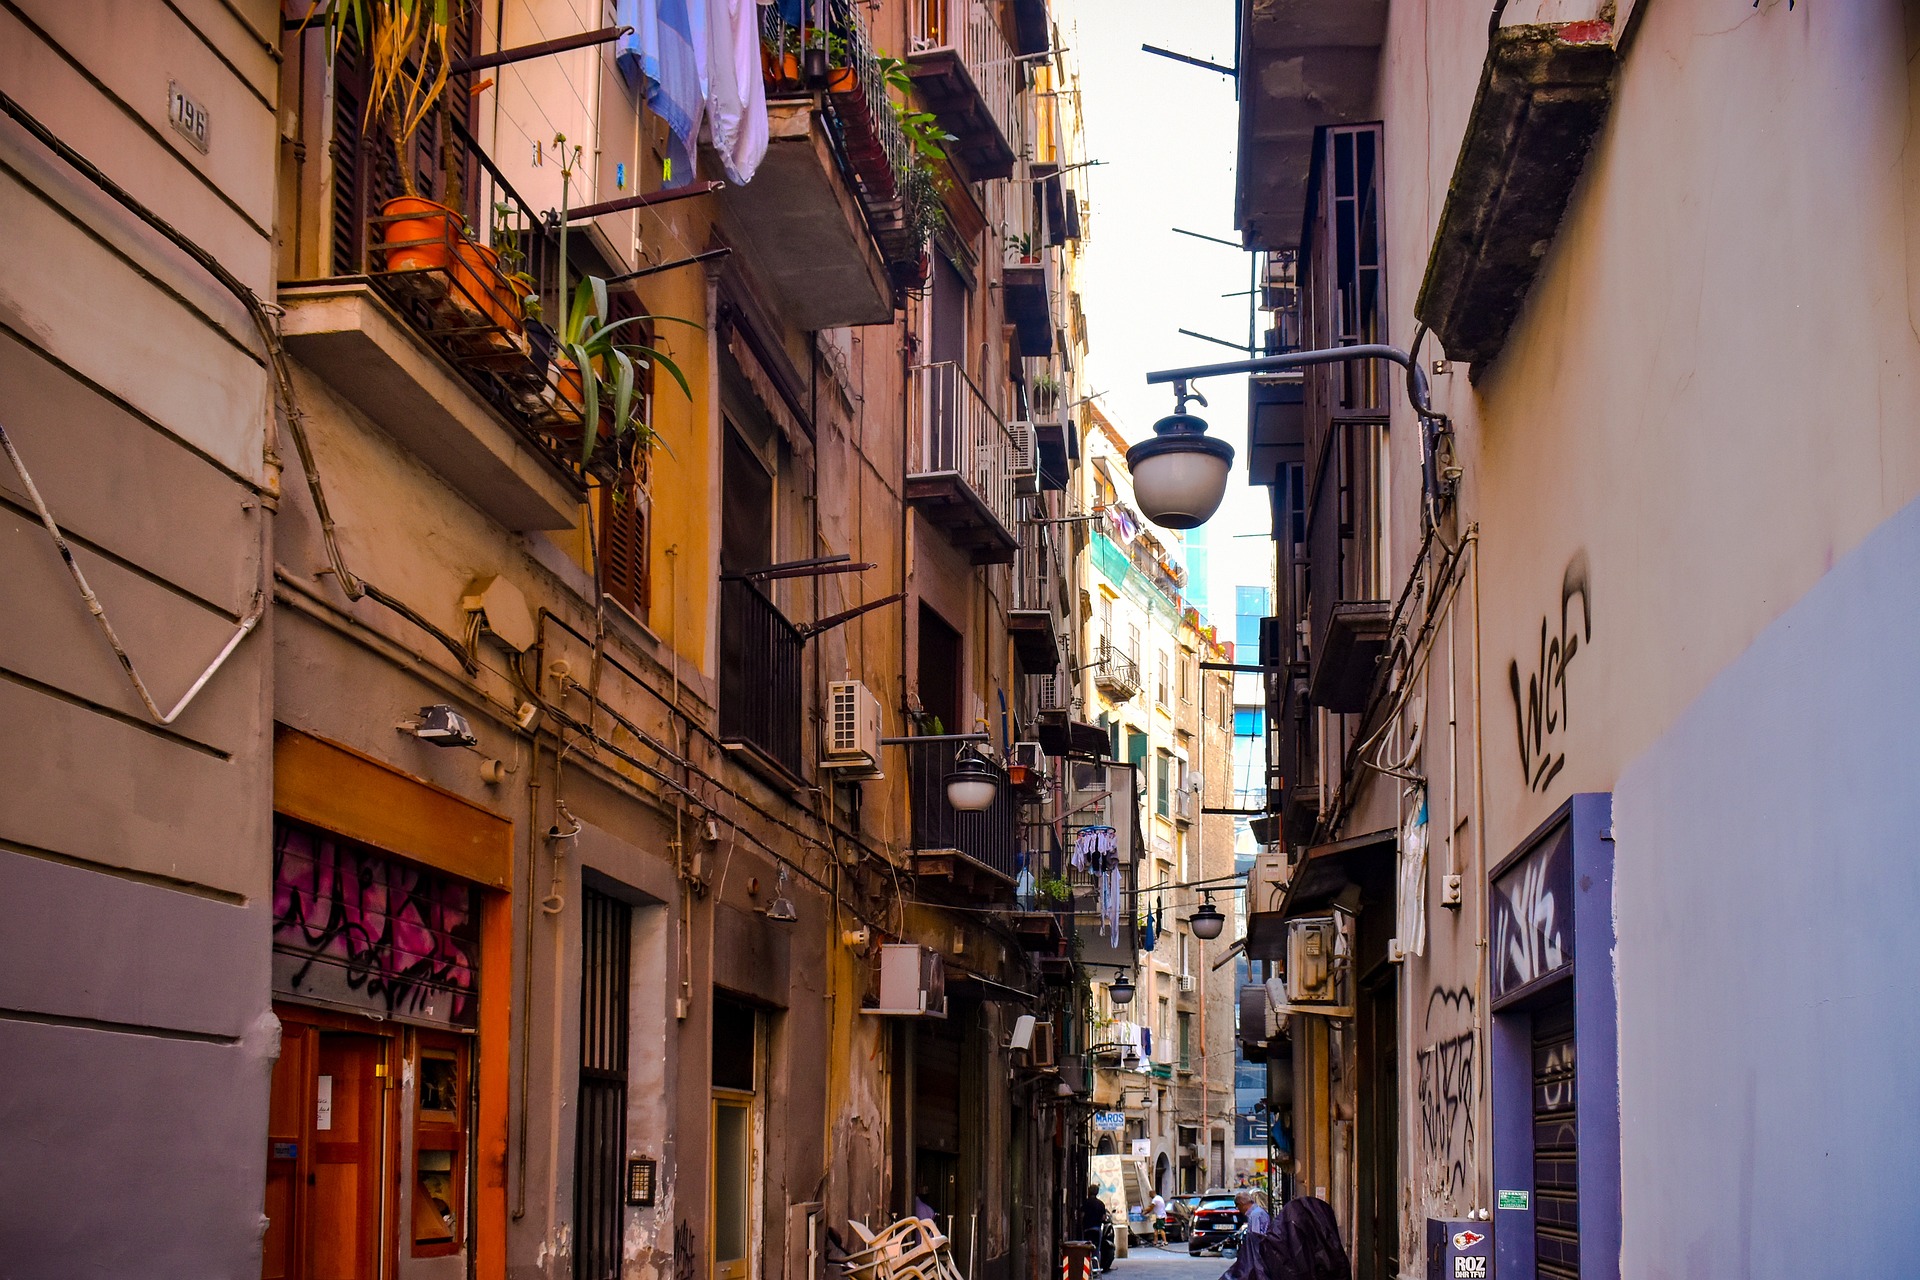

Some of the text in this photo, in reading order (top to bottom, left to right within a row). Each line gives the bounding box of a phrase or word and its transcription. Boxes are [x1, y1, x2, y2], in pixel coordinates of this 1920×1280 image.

[176, 94, 204, 141] 196
[1095, 1112, 1124, 1122] MAROS
[1455, 1256, 1486, 1271] ROZ
